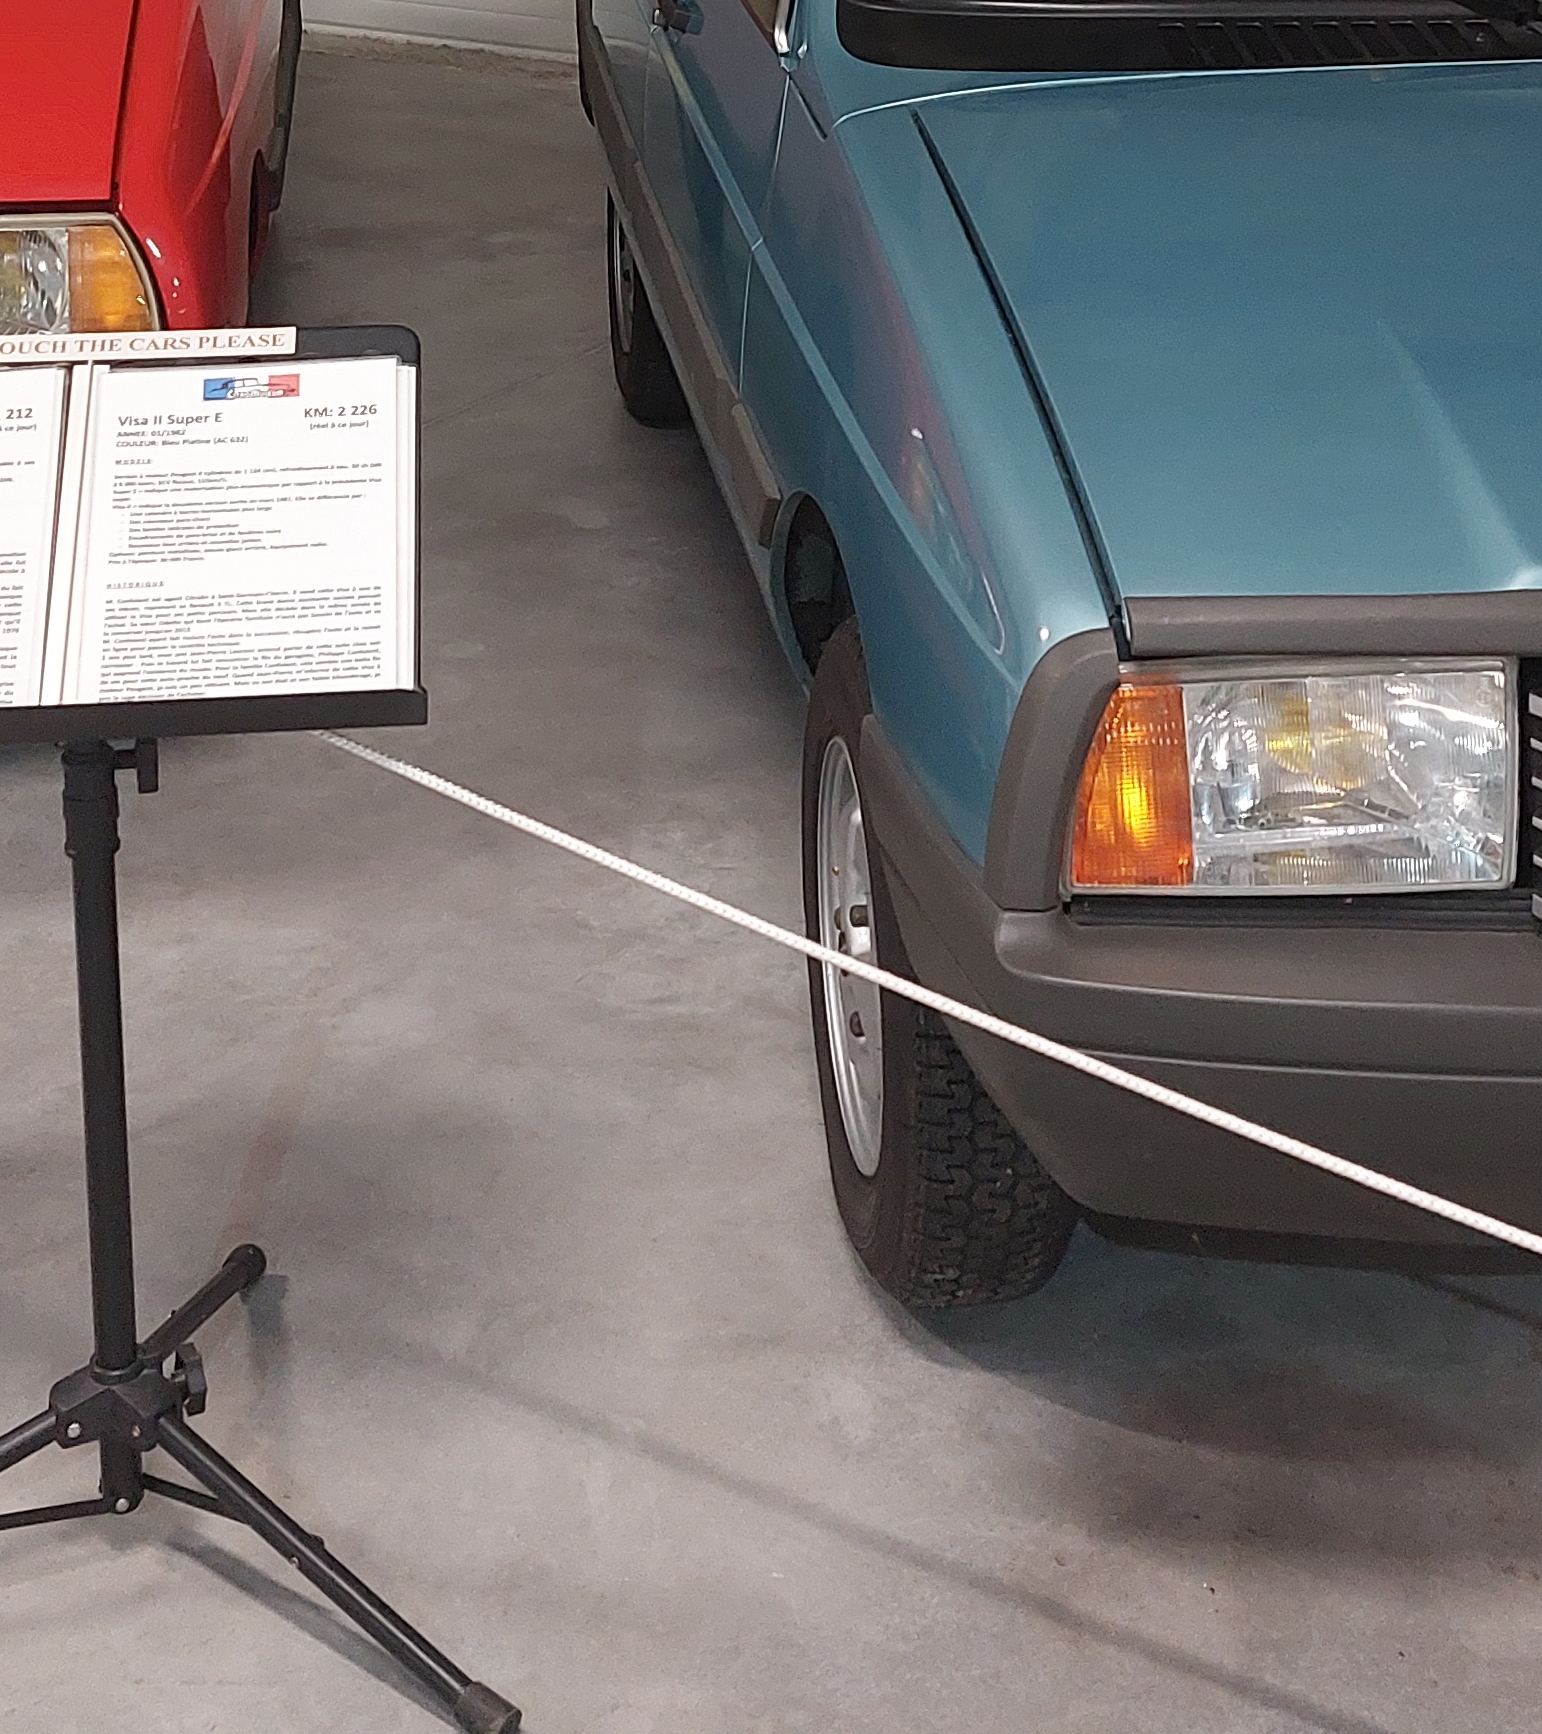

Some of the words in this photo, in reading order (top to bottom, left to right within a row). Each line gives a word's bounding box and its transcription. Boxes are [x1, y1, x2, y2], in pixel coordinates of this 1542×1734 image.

[74, 339, 123, 353] THE
[129, 336, 192, 351] CARS
[198, 333, 286, 350] PLEASE
[6, 407, 33, 420] 212
[304, 406, 333, 418] KM:
[337, 406, 347, 417] 2
[351, 404, 378, 416] 226
[118, 415, 149, 427] Visa
[154, 414, 163, 426] II
[167, 413, 211, 427] Super
[214, 412, 224, 423] E
